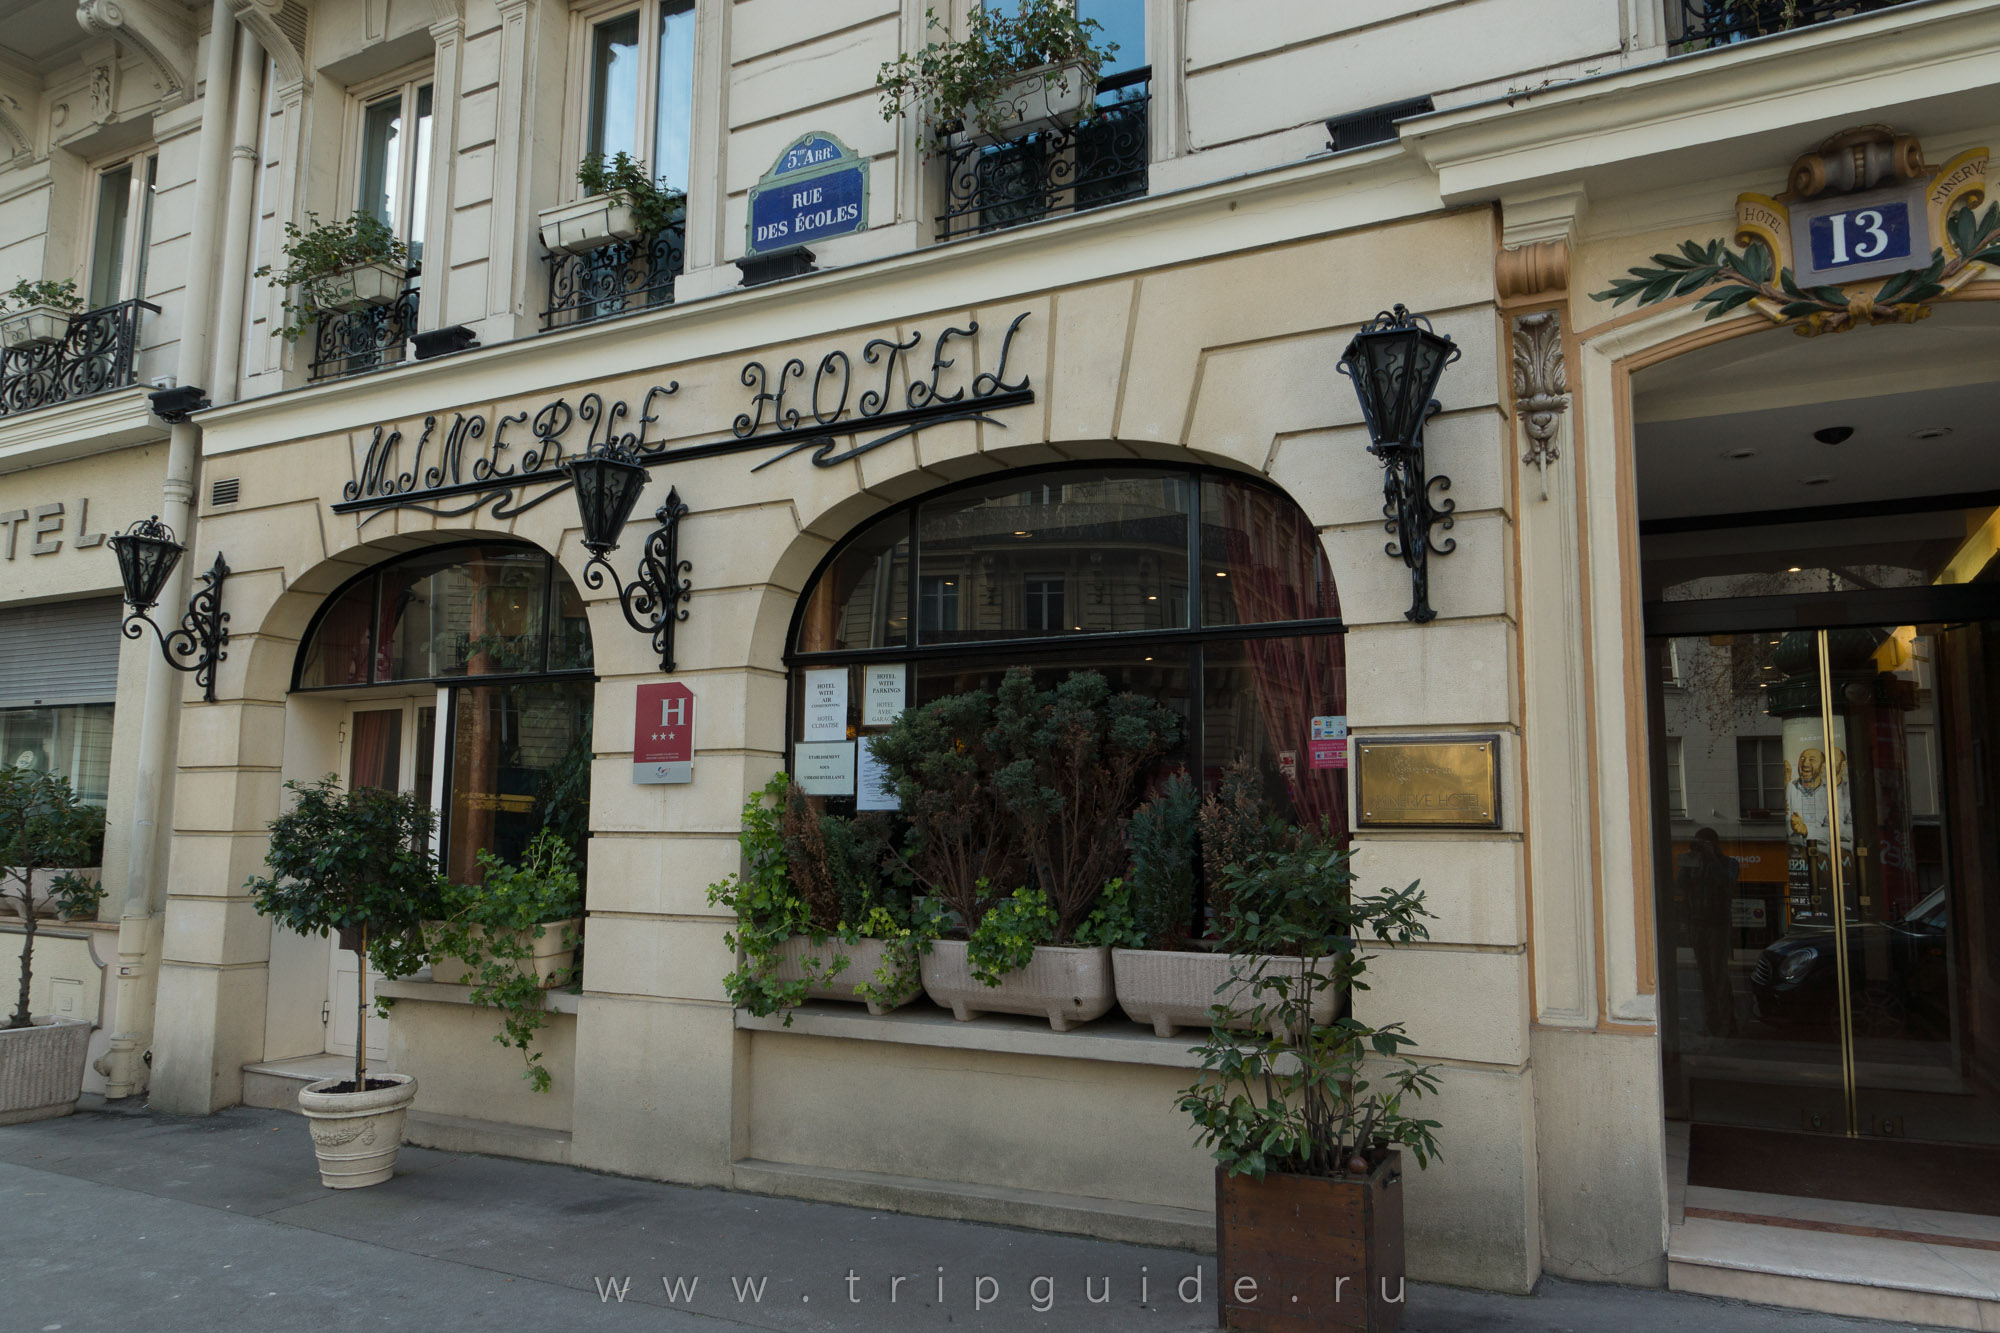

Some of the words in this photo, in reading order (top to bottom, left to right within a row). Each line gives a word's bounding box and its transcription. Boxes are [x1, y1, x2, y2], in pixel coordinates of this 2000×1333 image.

[792, 188, 822, 208] RUE
[1744, 206, 1781, 235] HOTEL
[1931, 159, 1986, 205] MINERVE
[756, 220, 789, 242] DES
[794, 203, 858, 233] ÉCOLES
[1829, 210, 1889, 264] 13
[342, 379, 679, 501] MINERVE
[732, 311, 1031, 438] HOTEL
[659, 697, 688, 727] H
